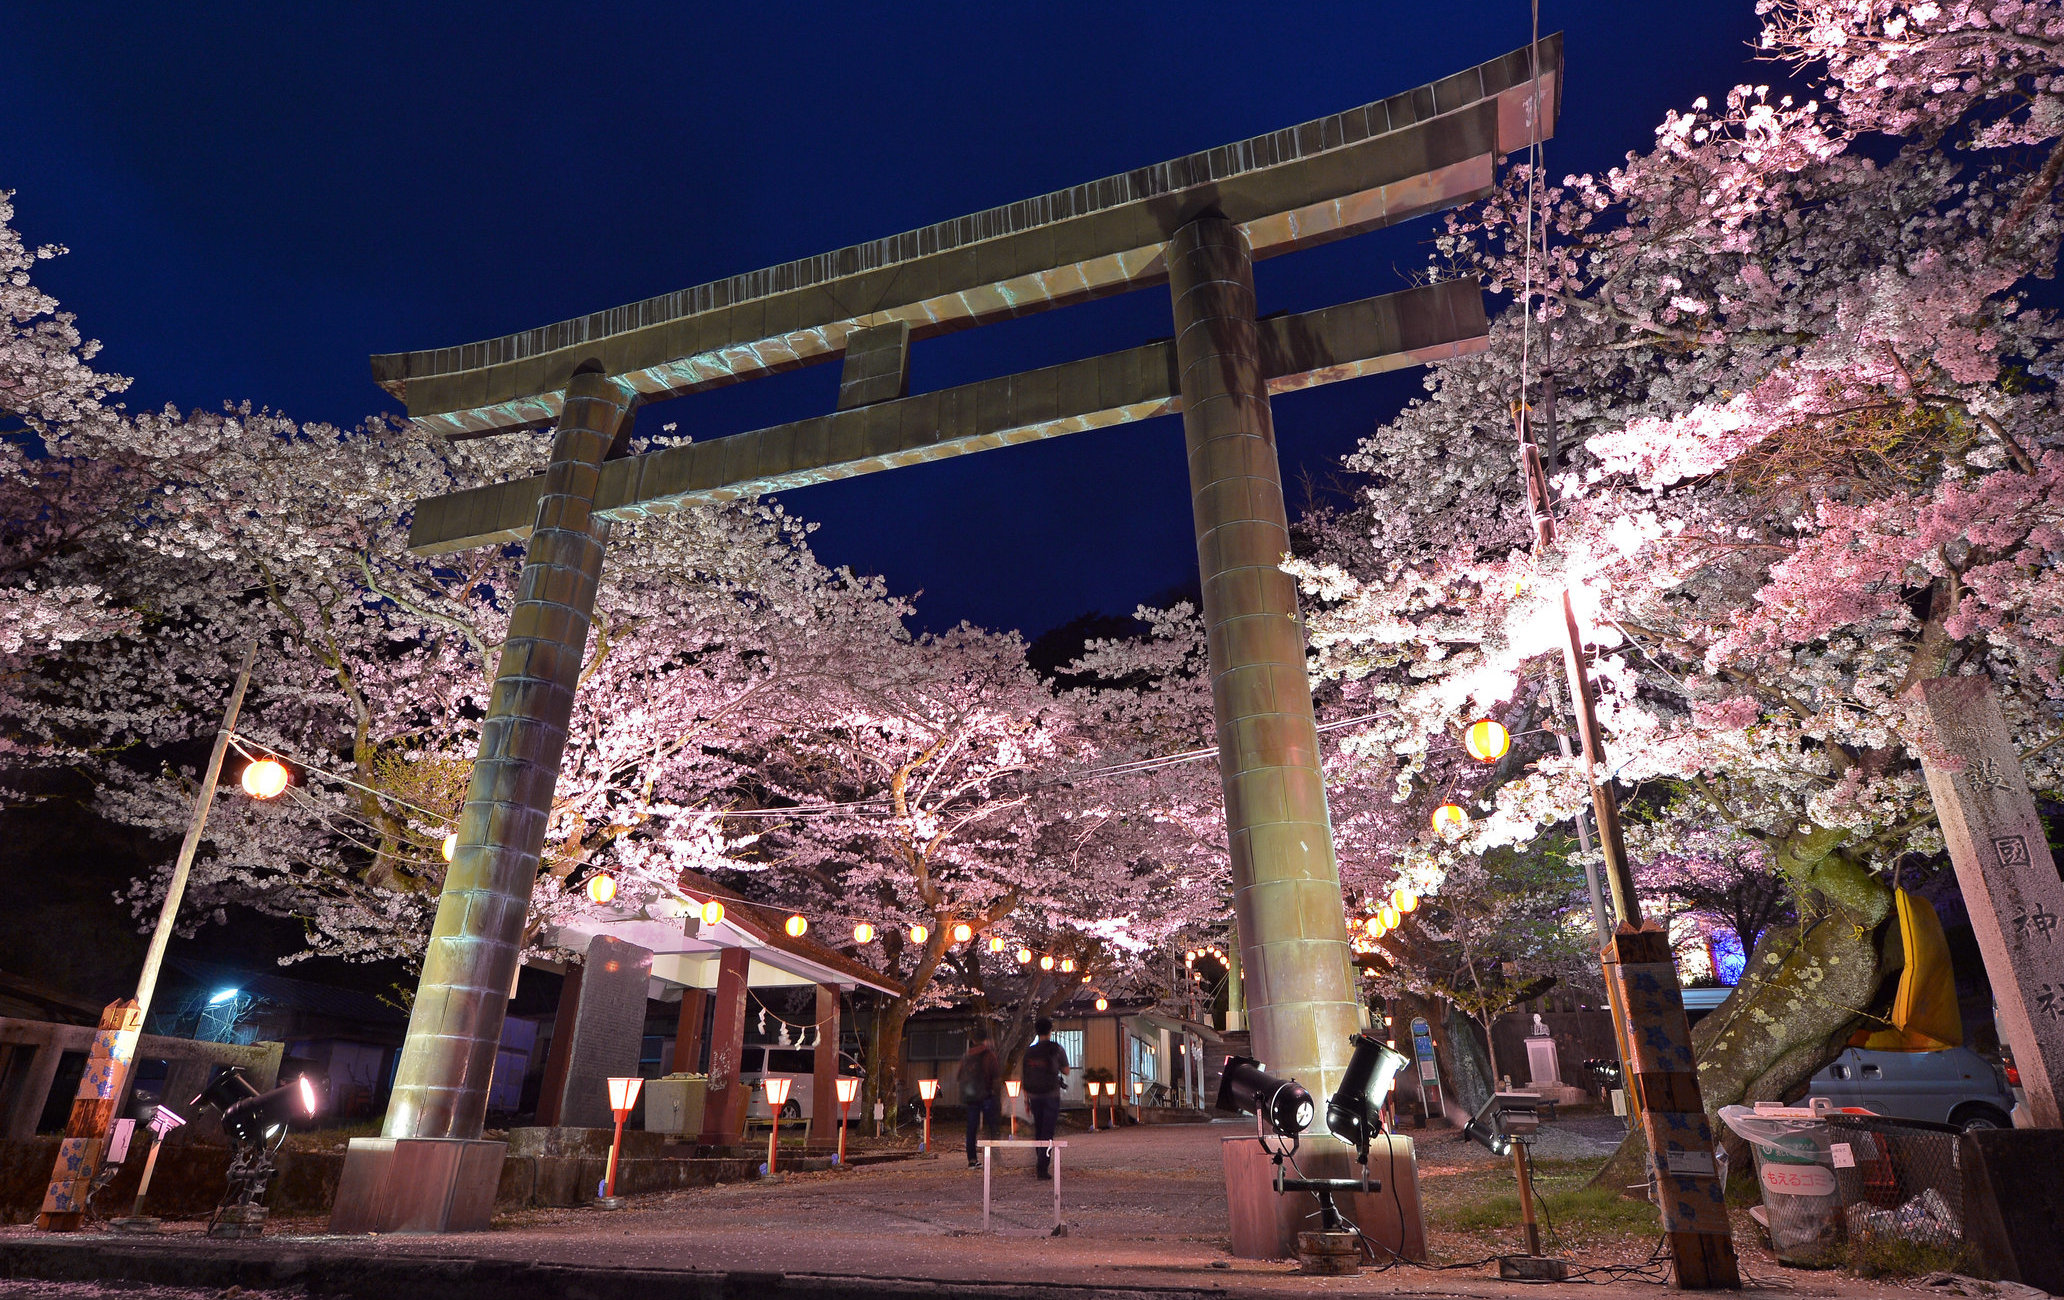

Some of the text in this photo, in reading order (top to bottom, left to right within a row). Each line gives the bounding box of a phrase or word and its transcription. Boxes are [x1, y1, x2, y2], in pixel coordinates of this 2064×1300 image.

[1767, 1171, 1828, 1187] もえるゴミ
